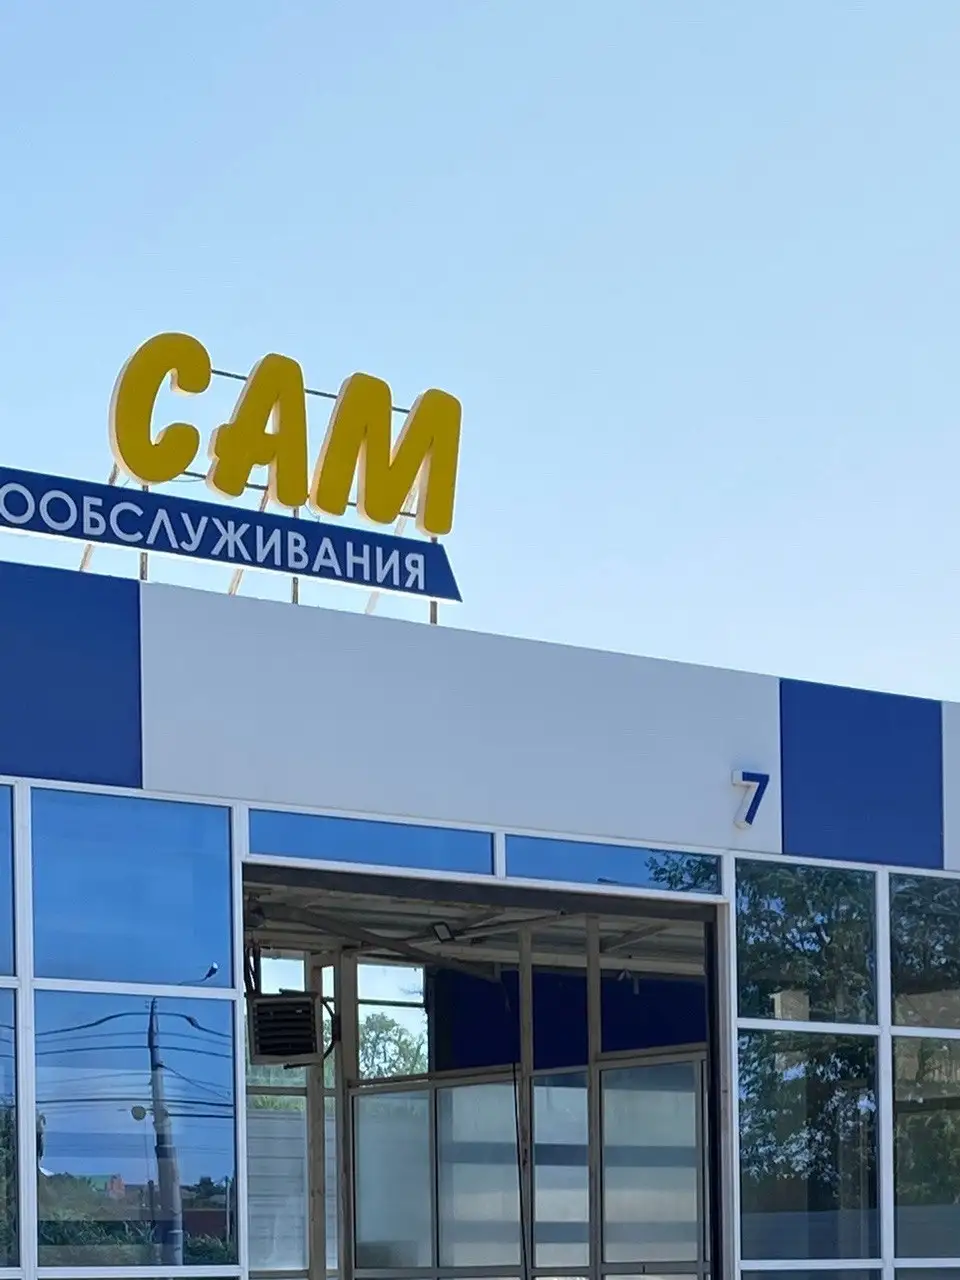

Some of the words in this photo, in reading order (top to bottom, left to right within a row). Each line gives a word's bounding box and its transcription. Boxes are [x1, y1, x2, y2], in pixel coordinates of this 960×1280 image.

[111, 332, 462, 536] САМ
[0, 482, 427, 591] ООБСЛУЖИВАНИЯ
[740, 770, 769, 826] 7
